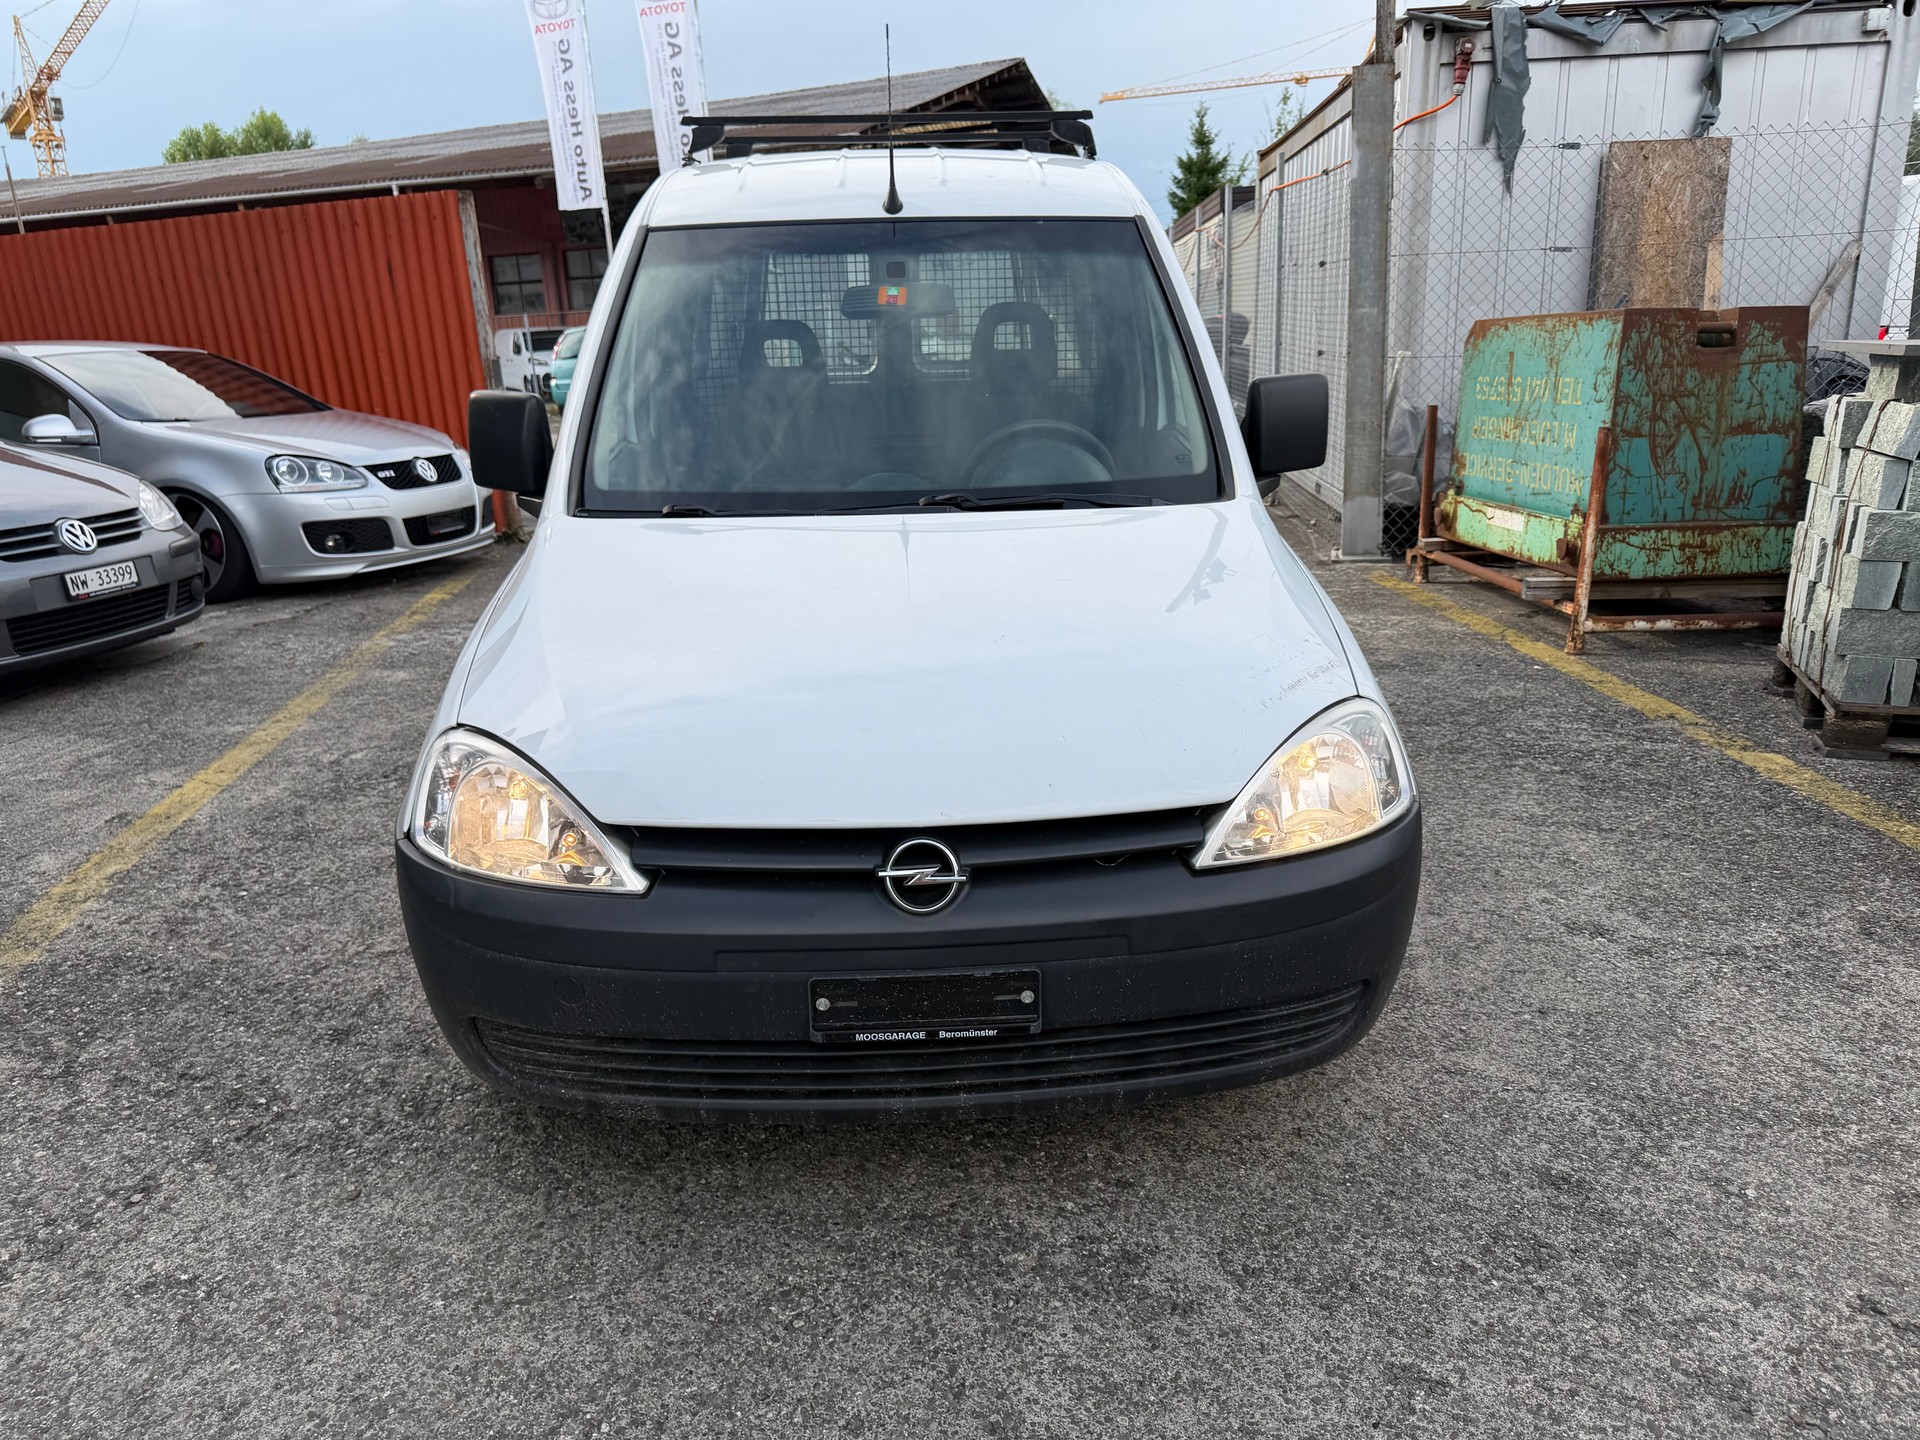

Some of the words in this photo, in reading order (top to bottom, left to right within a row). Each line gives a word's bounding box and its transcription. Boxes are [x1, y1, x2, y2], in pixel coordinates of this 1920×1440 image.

[1525, 376, 1550, 402] 041
[1561, 422, 1578, 449] M.
[69, 574, 89, 593] NW
[96, 564, 132, 587] 33399
[855, 1031, 926, 1041] MOOSGARAGE
[938, 1029, 998, 1039] Beromünster
